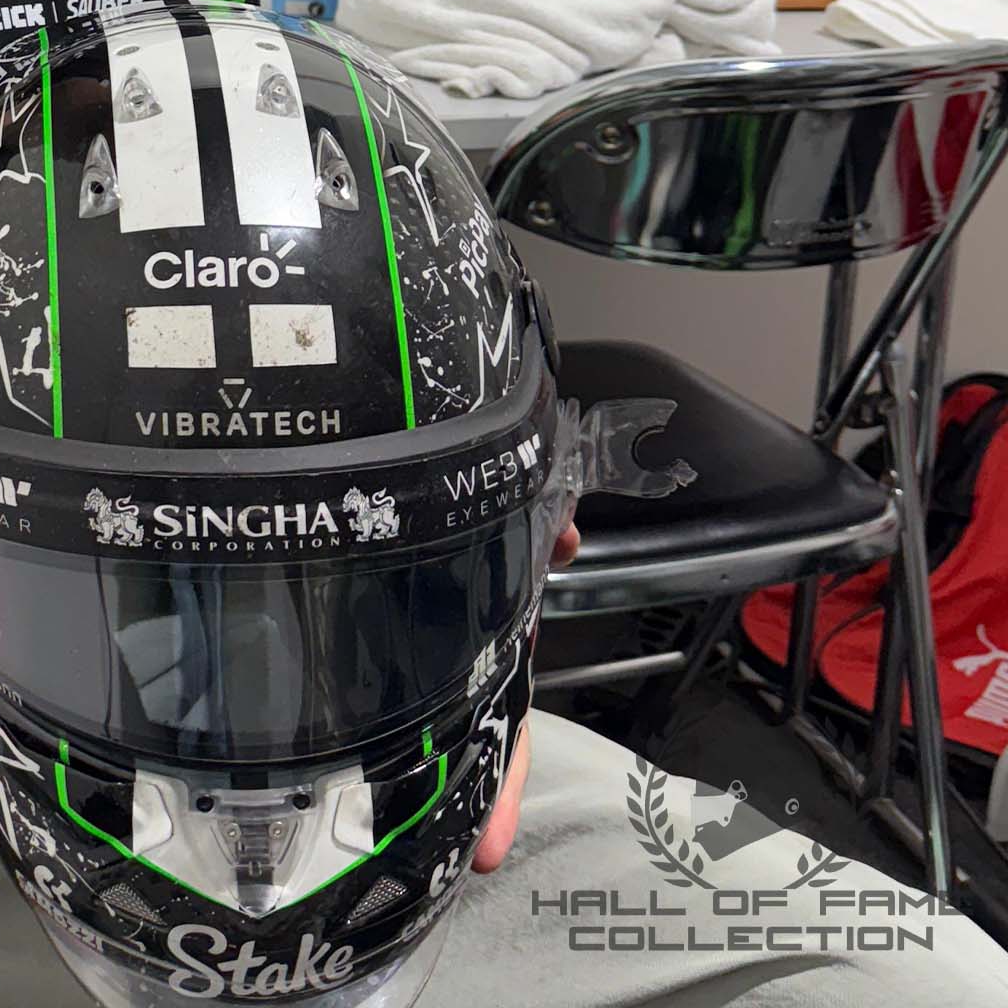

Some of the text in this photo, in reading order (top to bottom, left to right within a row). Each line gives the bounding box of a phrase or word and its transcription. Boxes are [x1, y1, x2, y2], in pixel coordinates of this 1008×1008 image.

[144, 249, 281, 289] Claro
[135, 409, 342, 437] VIBRATECH
[443, 451, 518, 502] WEB
[153, 537, 340, 552] CORPORATION
[167, 923, 355, 999] Stake
